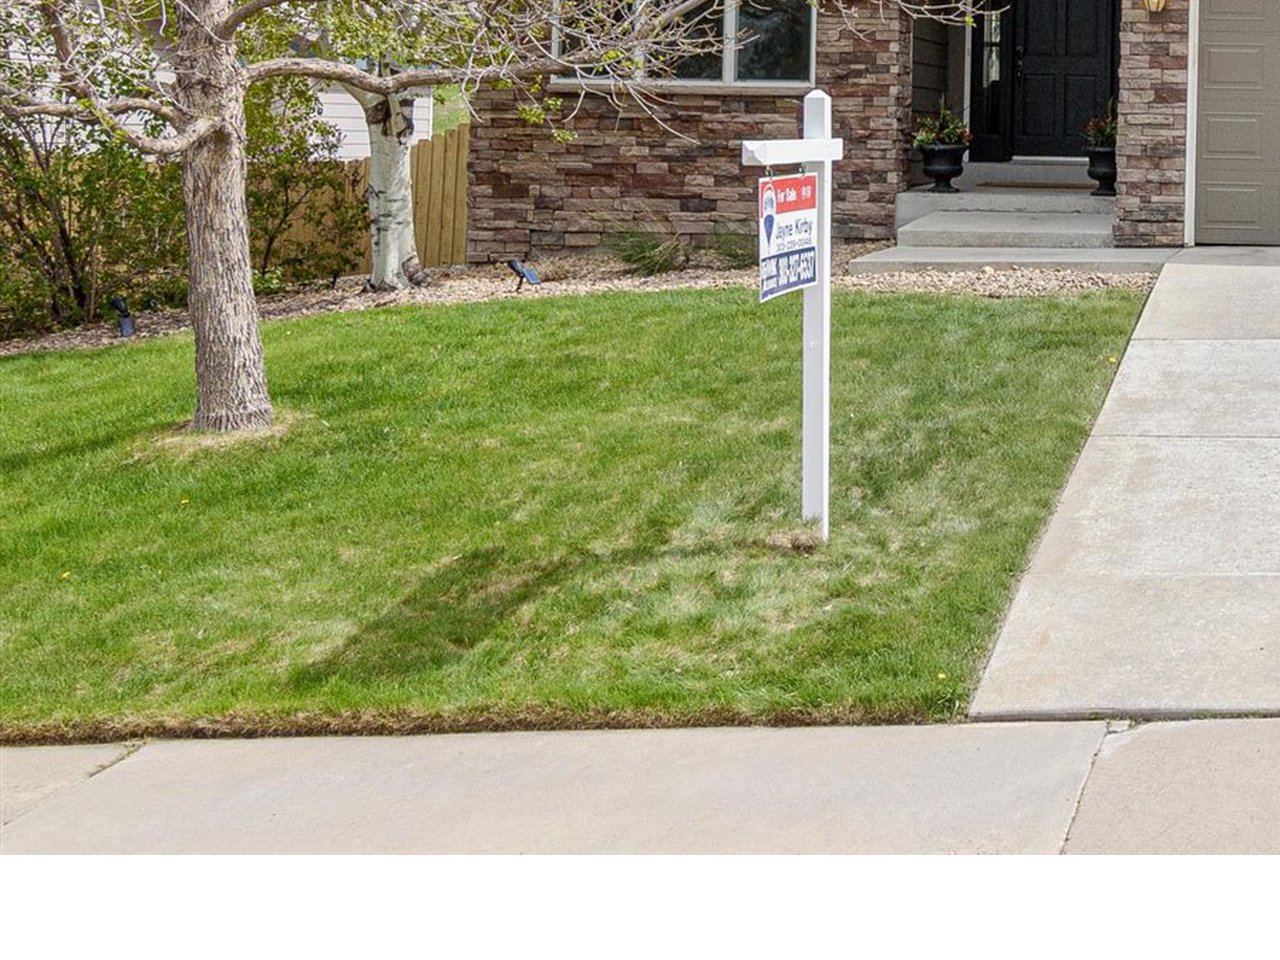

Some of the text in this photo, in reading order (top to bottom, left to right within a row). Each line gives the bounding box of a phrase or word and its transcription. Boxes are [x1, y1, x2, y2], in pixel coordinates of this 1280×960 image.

[785, 186, 798, 203] Sale
[776, 217, 813, 241] Jayne Kirby
